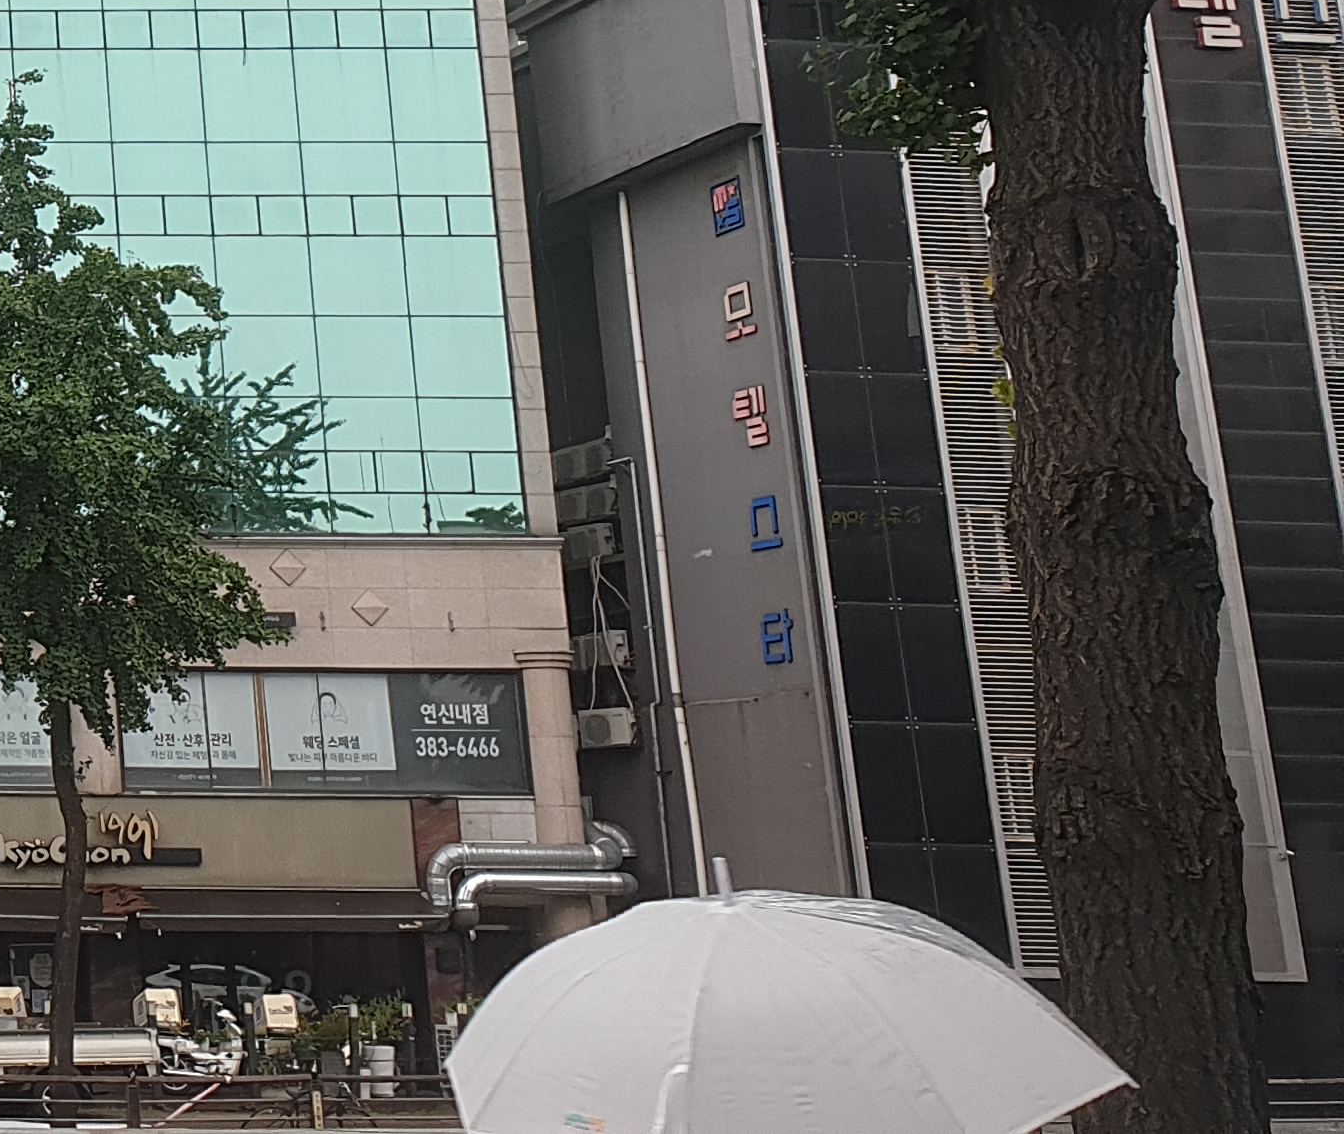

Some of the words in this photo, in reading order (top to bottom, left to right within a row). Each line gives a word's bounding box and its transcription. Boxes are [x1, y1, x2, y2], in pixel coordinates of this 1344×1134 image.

[418, 702, 491, 726] 연신내점
[19, 731, 41, 745] 얼굴
[210, 733, 233, 747] 관리
[327, 736, 361, 750] 스페셜
[415, 736, 500, 759] 383-6466
